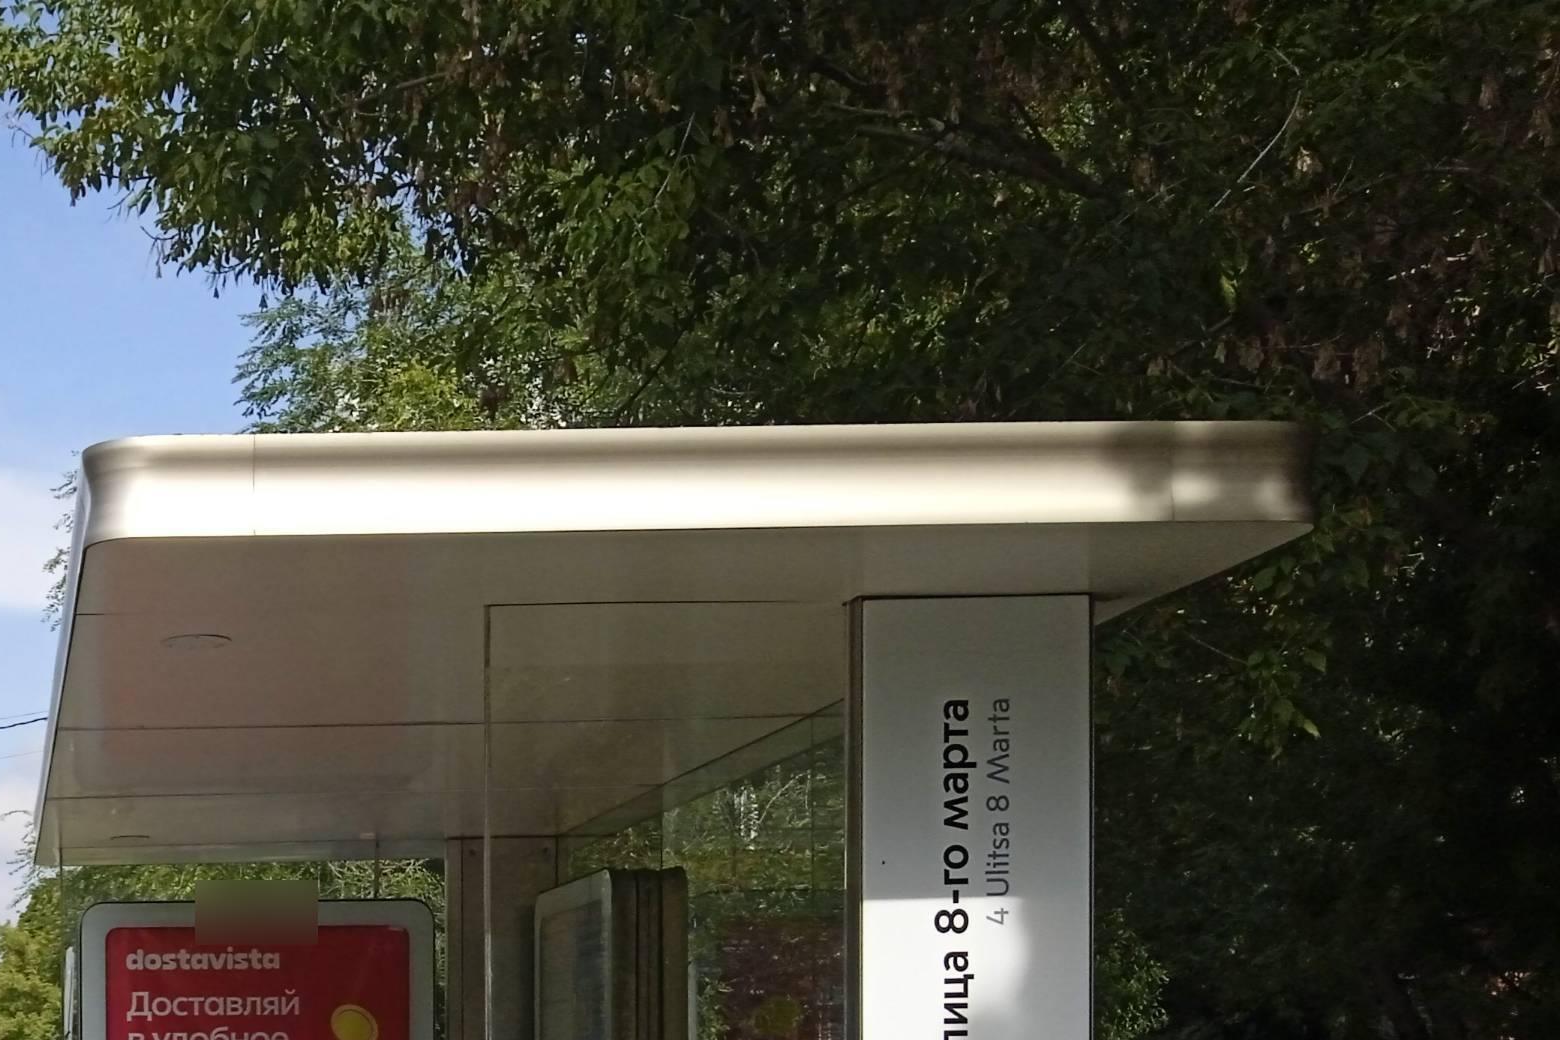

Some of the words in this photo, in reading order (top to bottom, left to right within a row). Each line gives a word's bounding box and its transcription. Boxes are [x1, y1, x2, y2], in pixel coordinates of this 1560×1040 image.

[943, 699, 977, 830] марта
[986, 698, 1010, 784] Marta
[986, 795, 1010, 812] 8
[985, 822, 1010, 896] Ulitsa
[934, 844, 970, 934] 8-го
[986, 907, 1009, 925] 4
[126, 947, 280, 971] dostavista
[126, 988, 300, 1021] Доставляй
